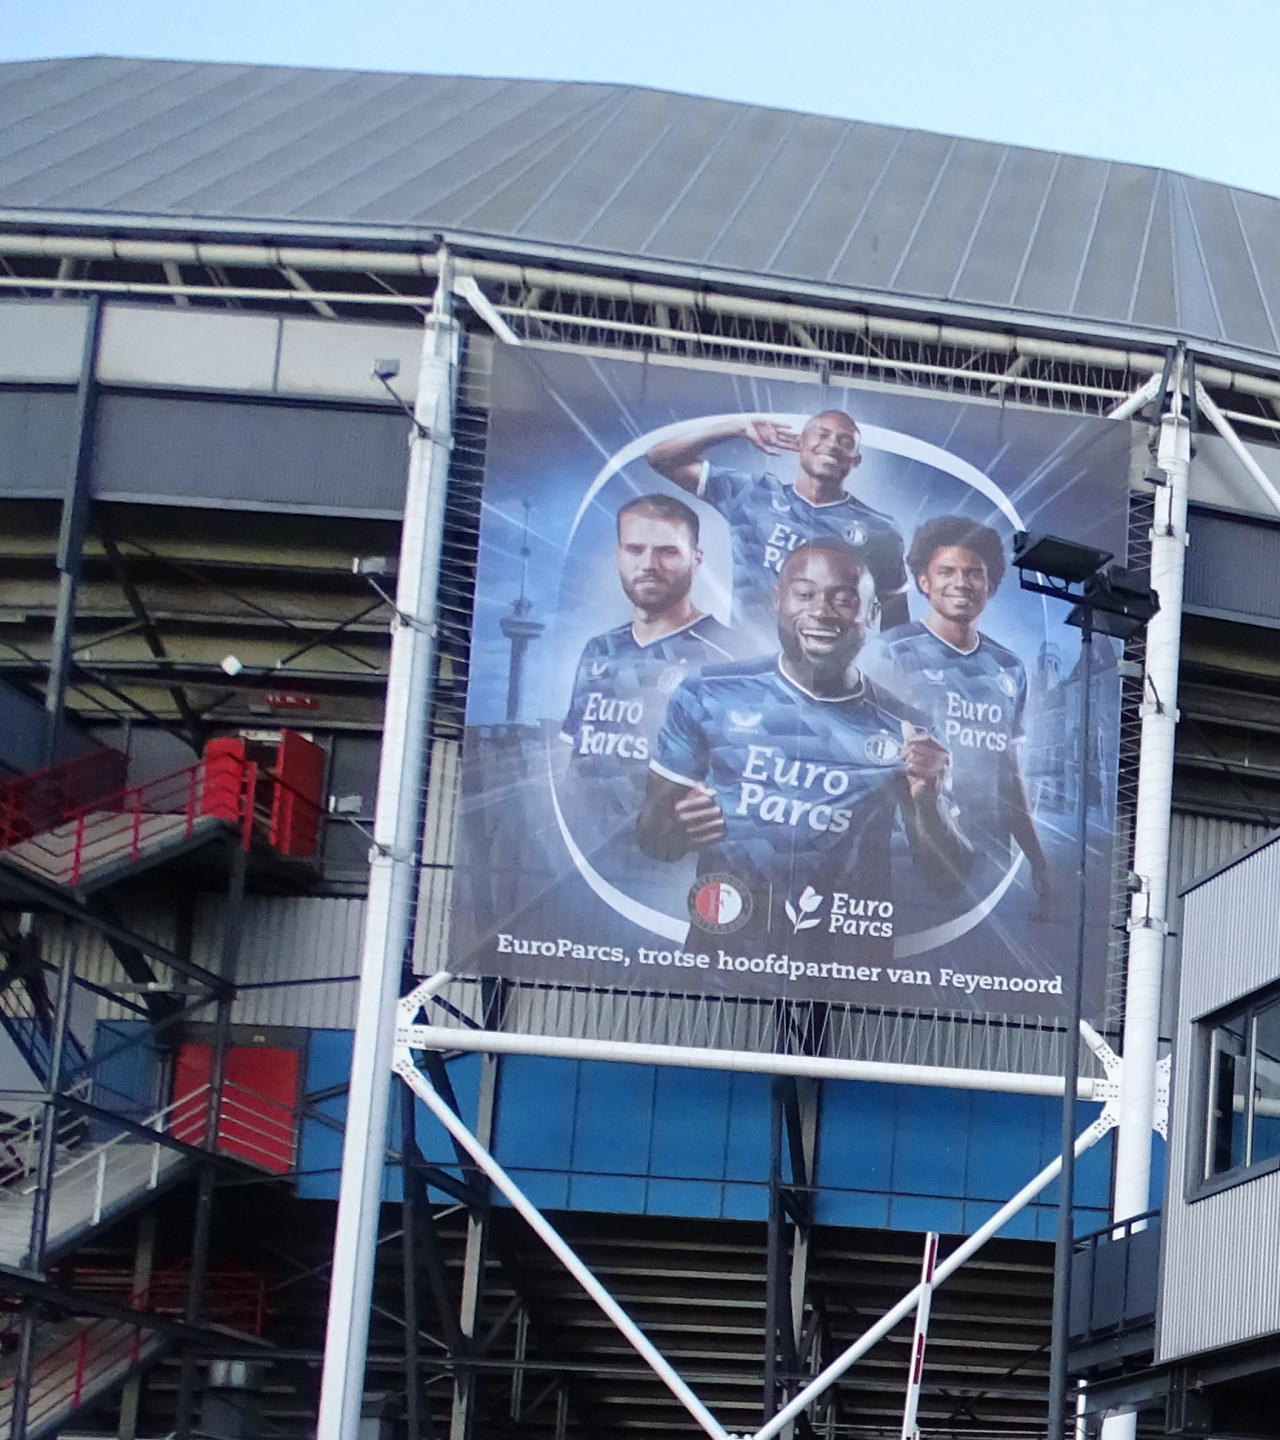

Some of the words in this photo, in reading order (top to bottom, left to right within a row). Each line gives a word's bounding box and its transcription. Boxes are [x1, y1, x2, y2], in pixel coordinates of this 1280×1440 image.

[583, 692, 644, 725] Euro
[945, 691, 1002, 724] Euro
[579, 725, 650, 761] Parcs
[944, 719, 1009, 752] Parcs
[741, 744, 850, 796] Euro
[735, 782, 854, 833] Parcs
[831, 892, 894, 918] Euro
[828, 914, 894, 938] Parcs
[497, 934, 632, 967] EuroParcs,
[637, 946, 710, 969] trotse
[717, 950, 882, 982] hoofdpartner
[887, 968, 932, 985] van
[939, 968, 1064, 995] Feyenoord
